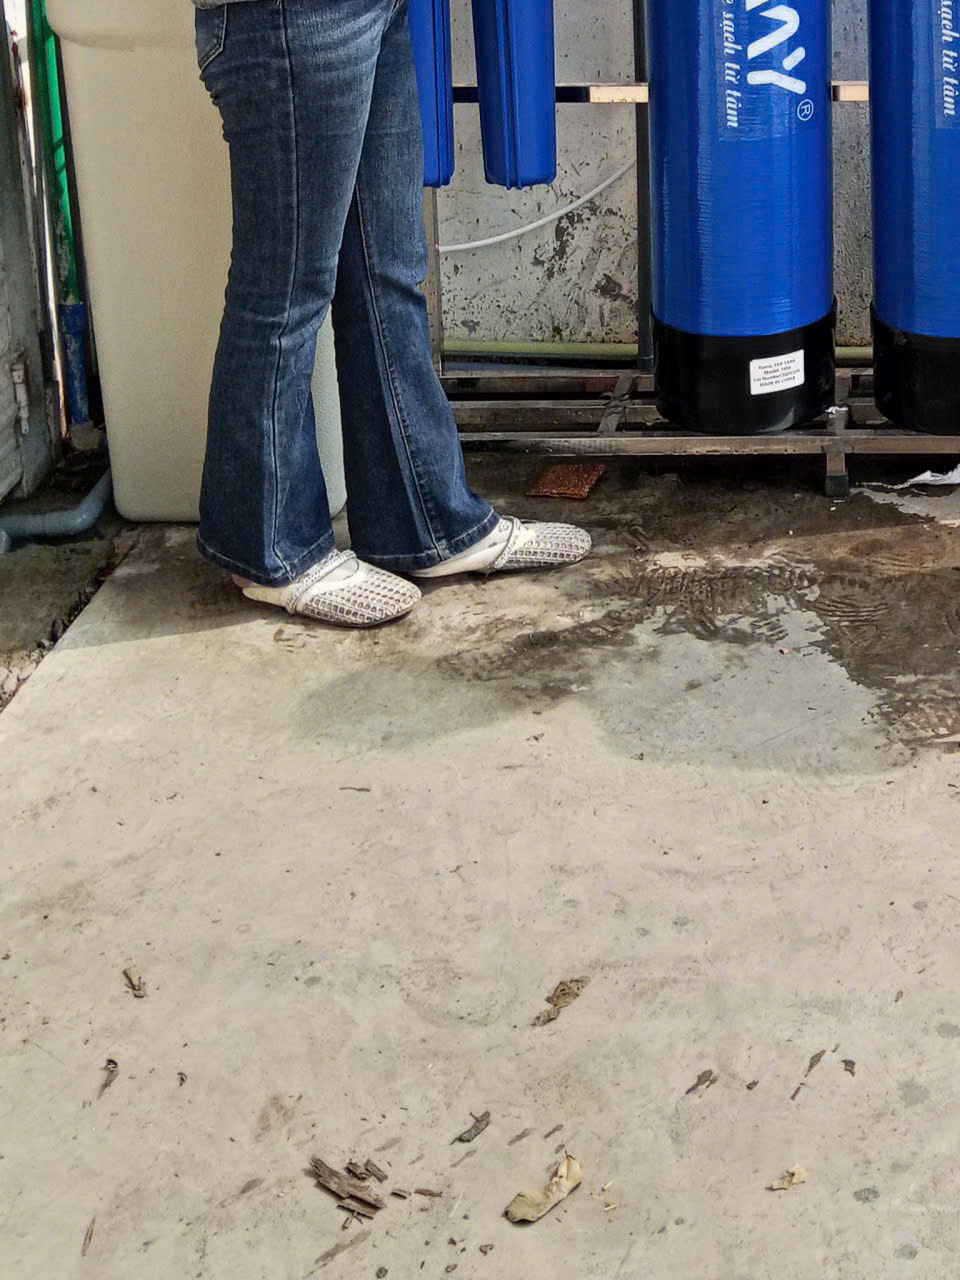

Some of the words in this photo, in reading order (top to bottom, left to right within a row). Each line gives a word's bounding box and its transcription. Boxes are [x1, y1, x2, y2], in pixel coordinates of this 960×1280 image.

[719, 16, 743, 56] sạch
[937, 0, 960, 41] sạch
[724, 61, 742, 89] từ
[942, 44, 960, 74] từ
[724, 94, 742, 129] tâm
[942, 77, 960, 118] tâm
